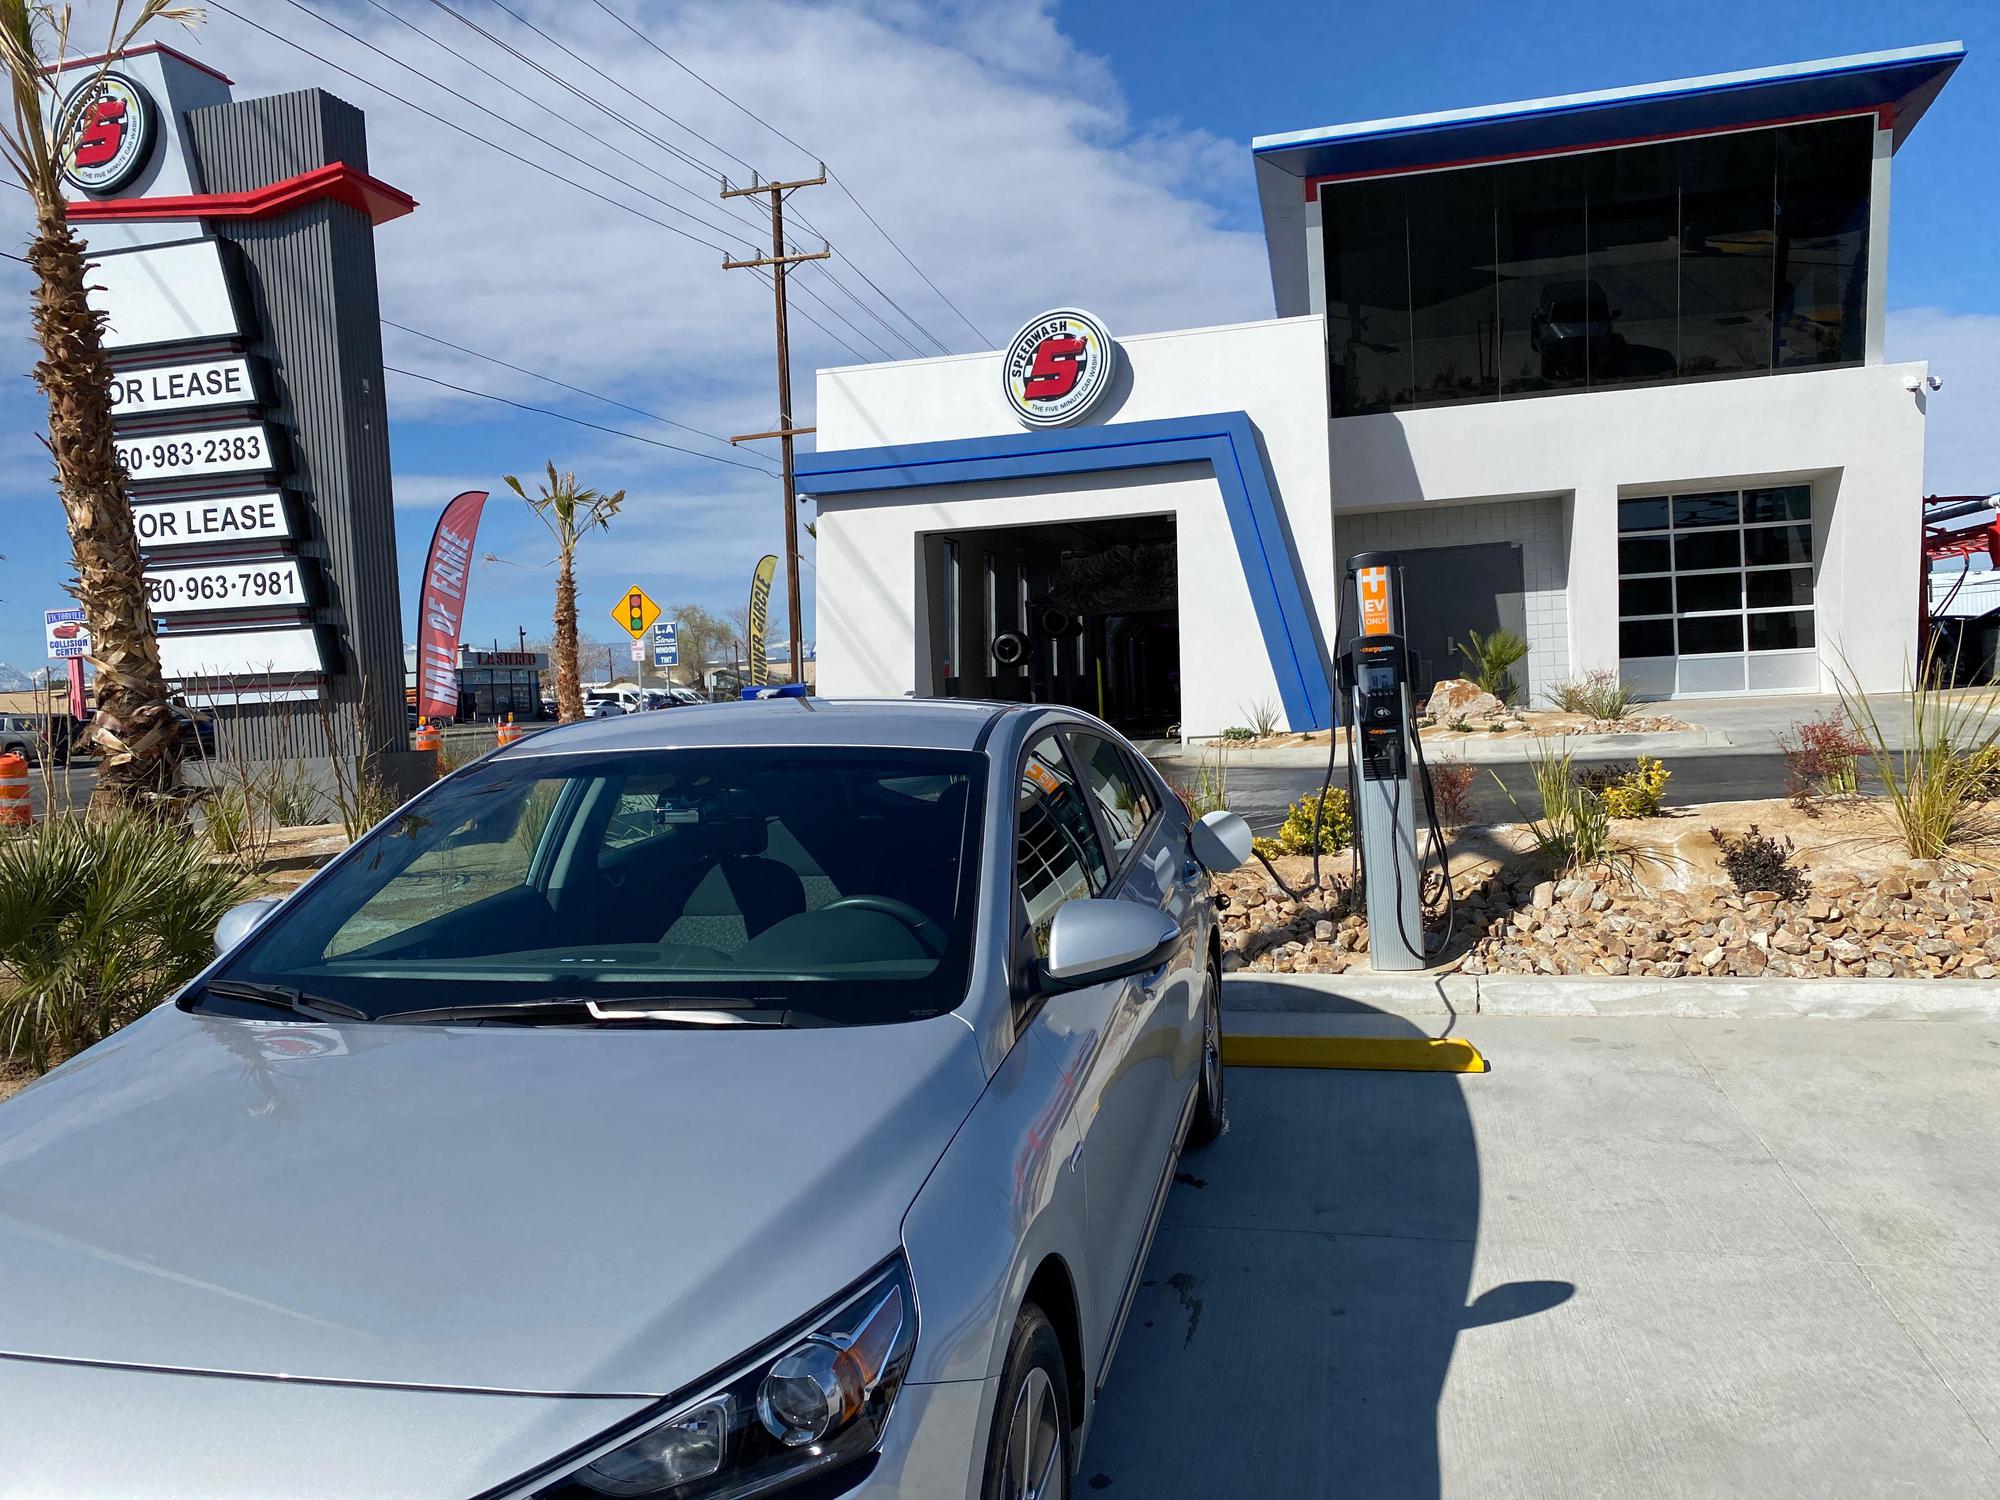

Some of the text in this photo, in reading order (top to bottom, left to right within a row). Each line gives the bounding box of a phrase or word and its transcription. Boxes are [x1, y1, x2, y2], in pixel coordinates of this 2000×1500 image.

[1012, 321, 1067, 378] SPEEDWASH
[107, 367, 241, 406] OR LEASE
[1032, 403, 1044, 413] THE
[1059, 391, 1083, 410] MINUTE
[1081, 378, 1093, 392] CAR
[133, 503, 276, 538] OR LEASE
[425, 524, 470, 706] HALL OF FAME
[752, 573, 771, 633] CIRCLE
[1364, 598, 1385, 612] EV
[1366, 617, 1386, 625] ONLY
[50, 639, 88, 649] COLLISION
[55, 647, 83, 656] CENTER
[655, 646, 676, 654] WINDOW
